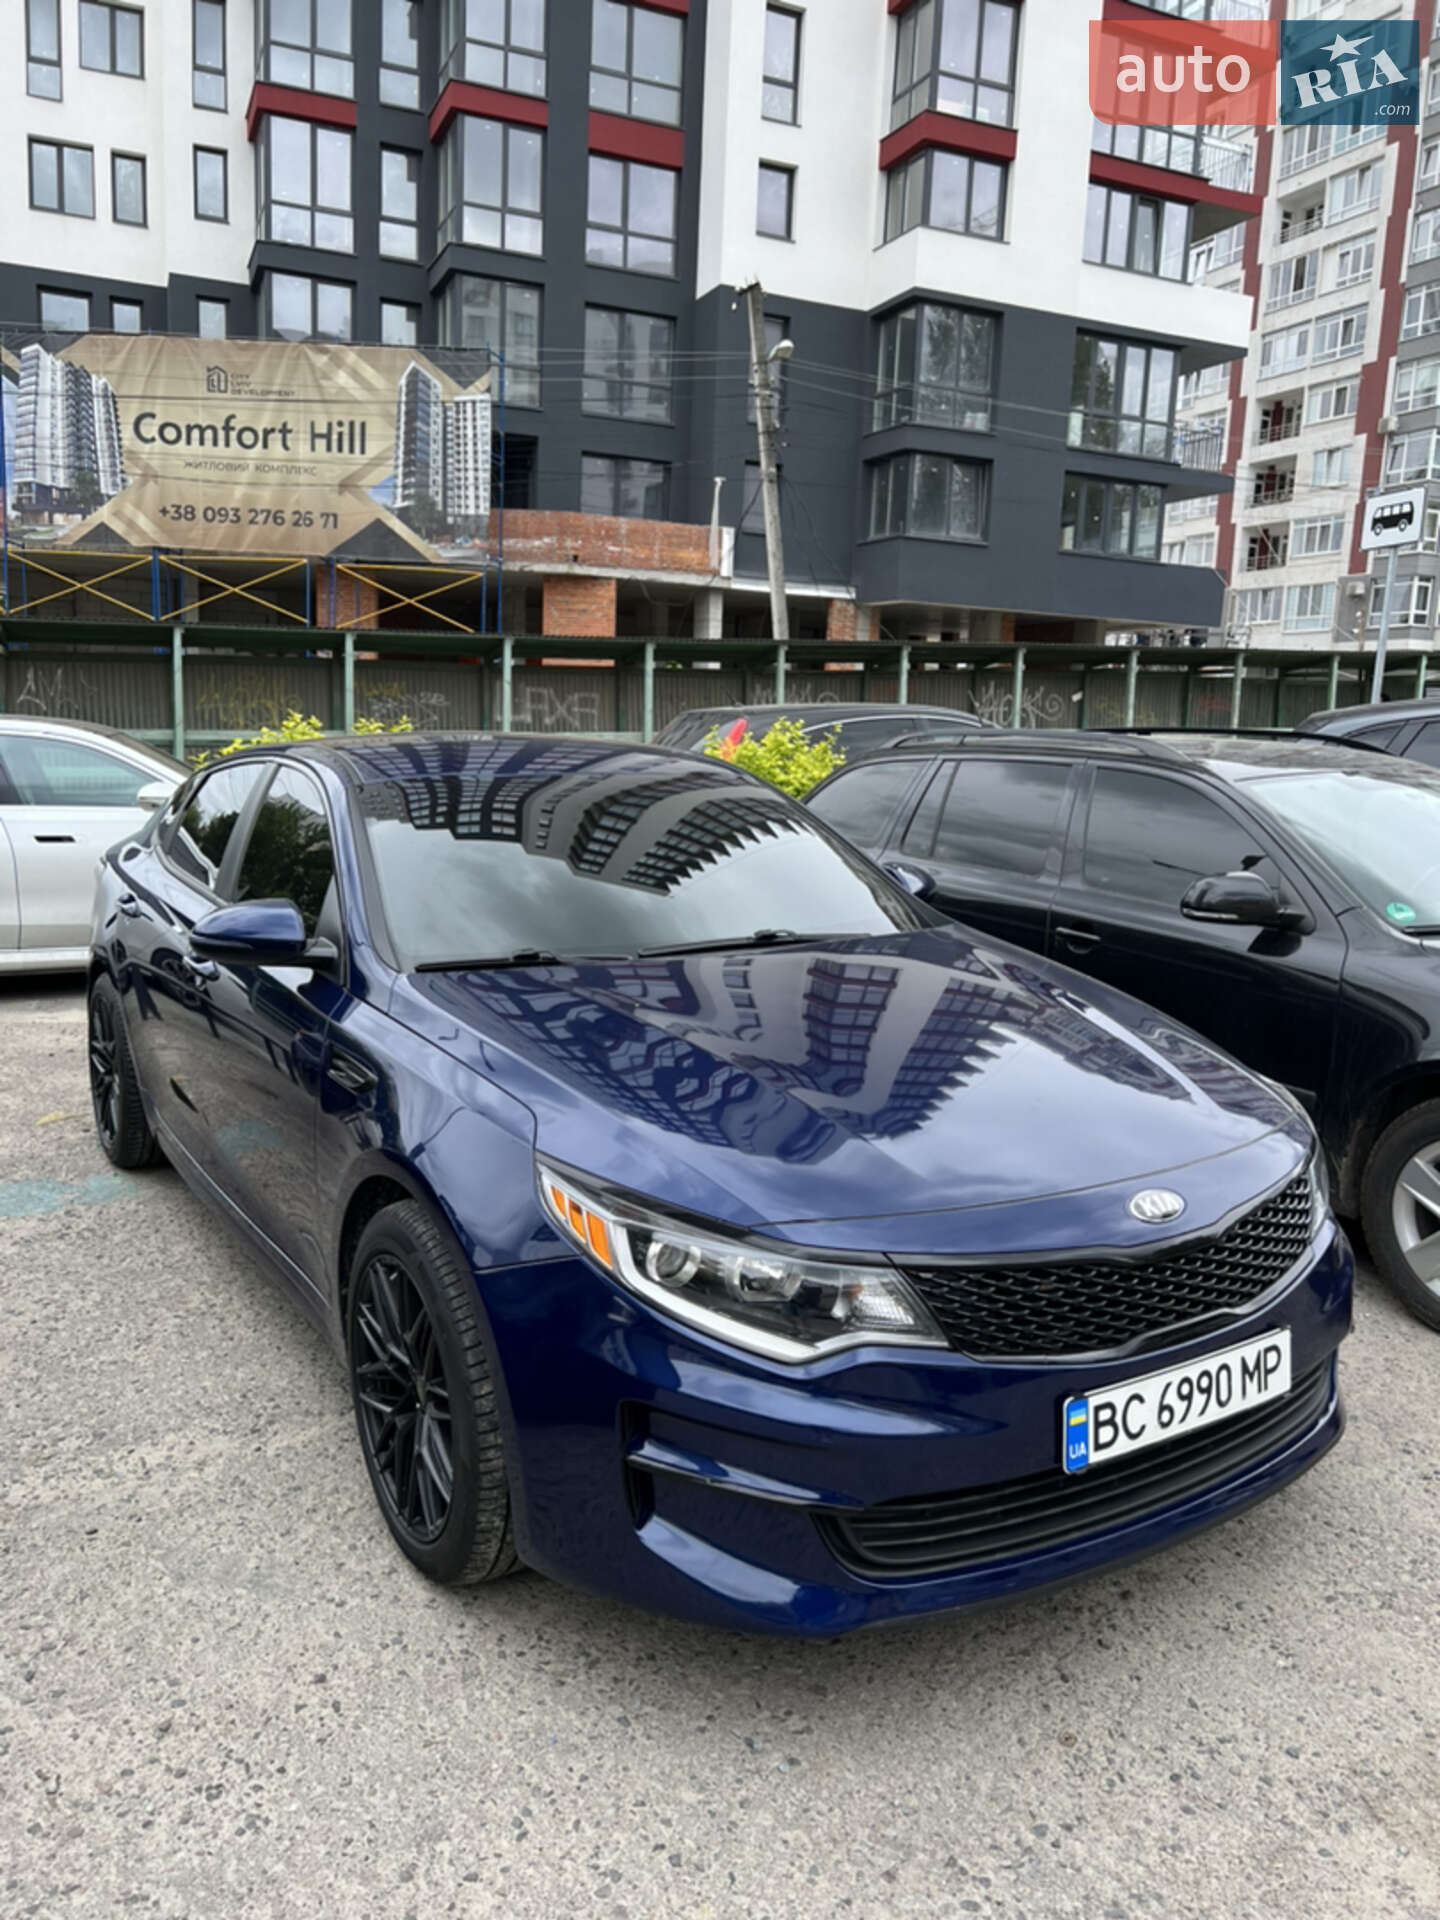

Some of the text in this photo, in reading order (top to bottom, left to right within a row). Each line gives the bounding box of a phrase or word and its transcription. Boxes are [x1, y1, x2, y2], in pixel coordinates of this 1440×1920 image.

[133, 411, 367, 456] Comfort Hill
[159, 504, 339, 530] +38 093 276 26 71
[1093, 1344, 1282, 1452] BC 6990 MP
[1069, 1441, 1087, 1460] UA
